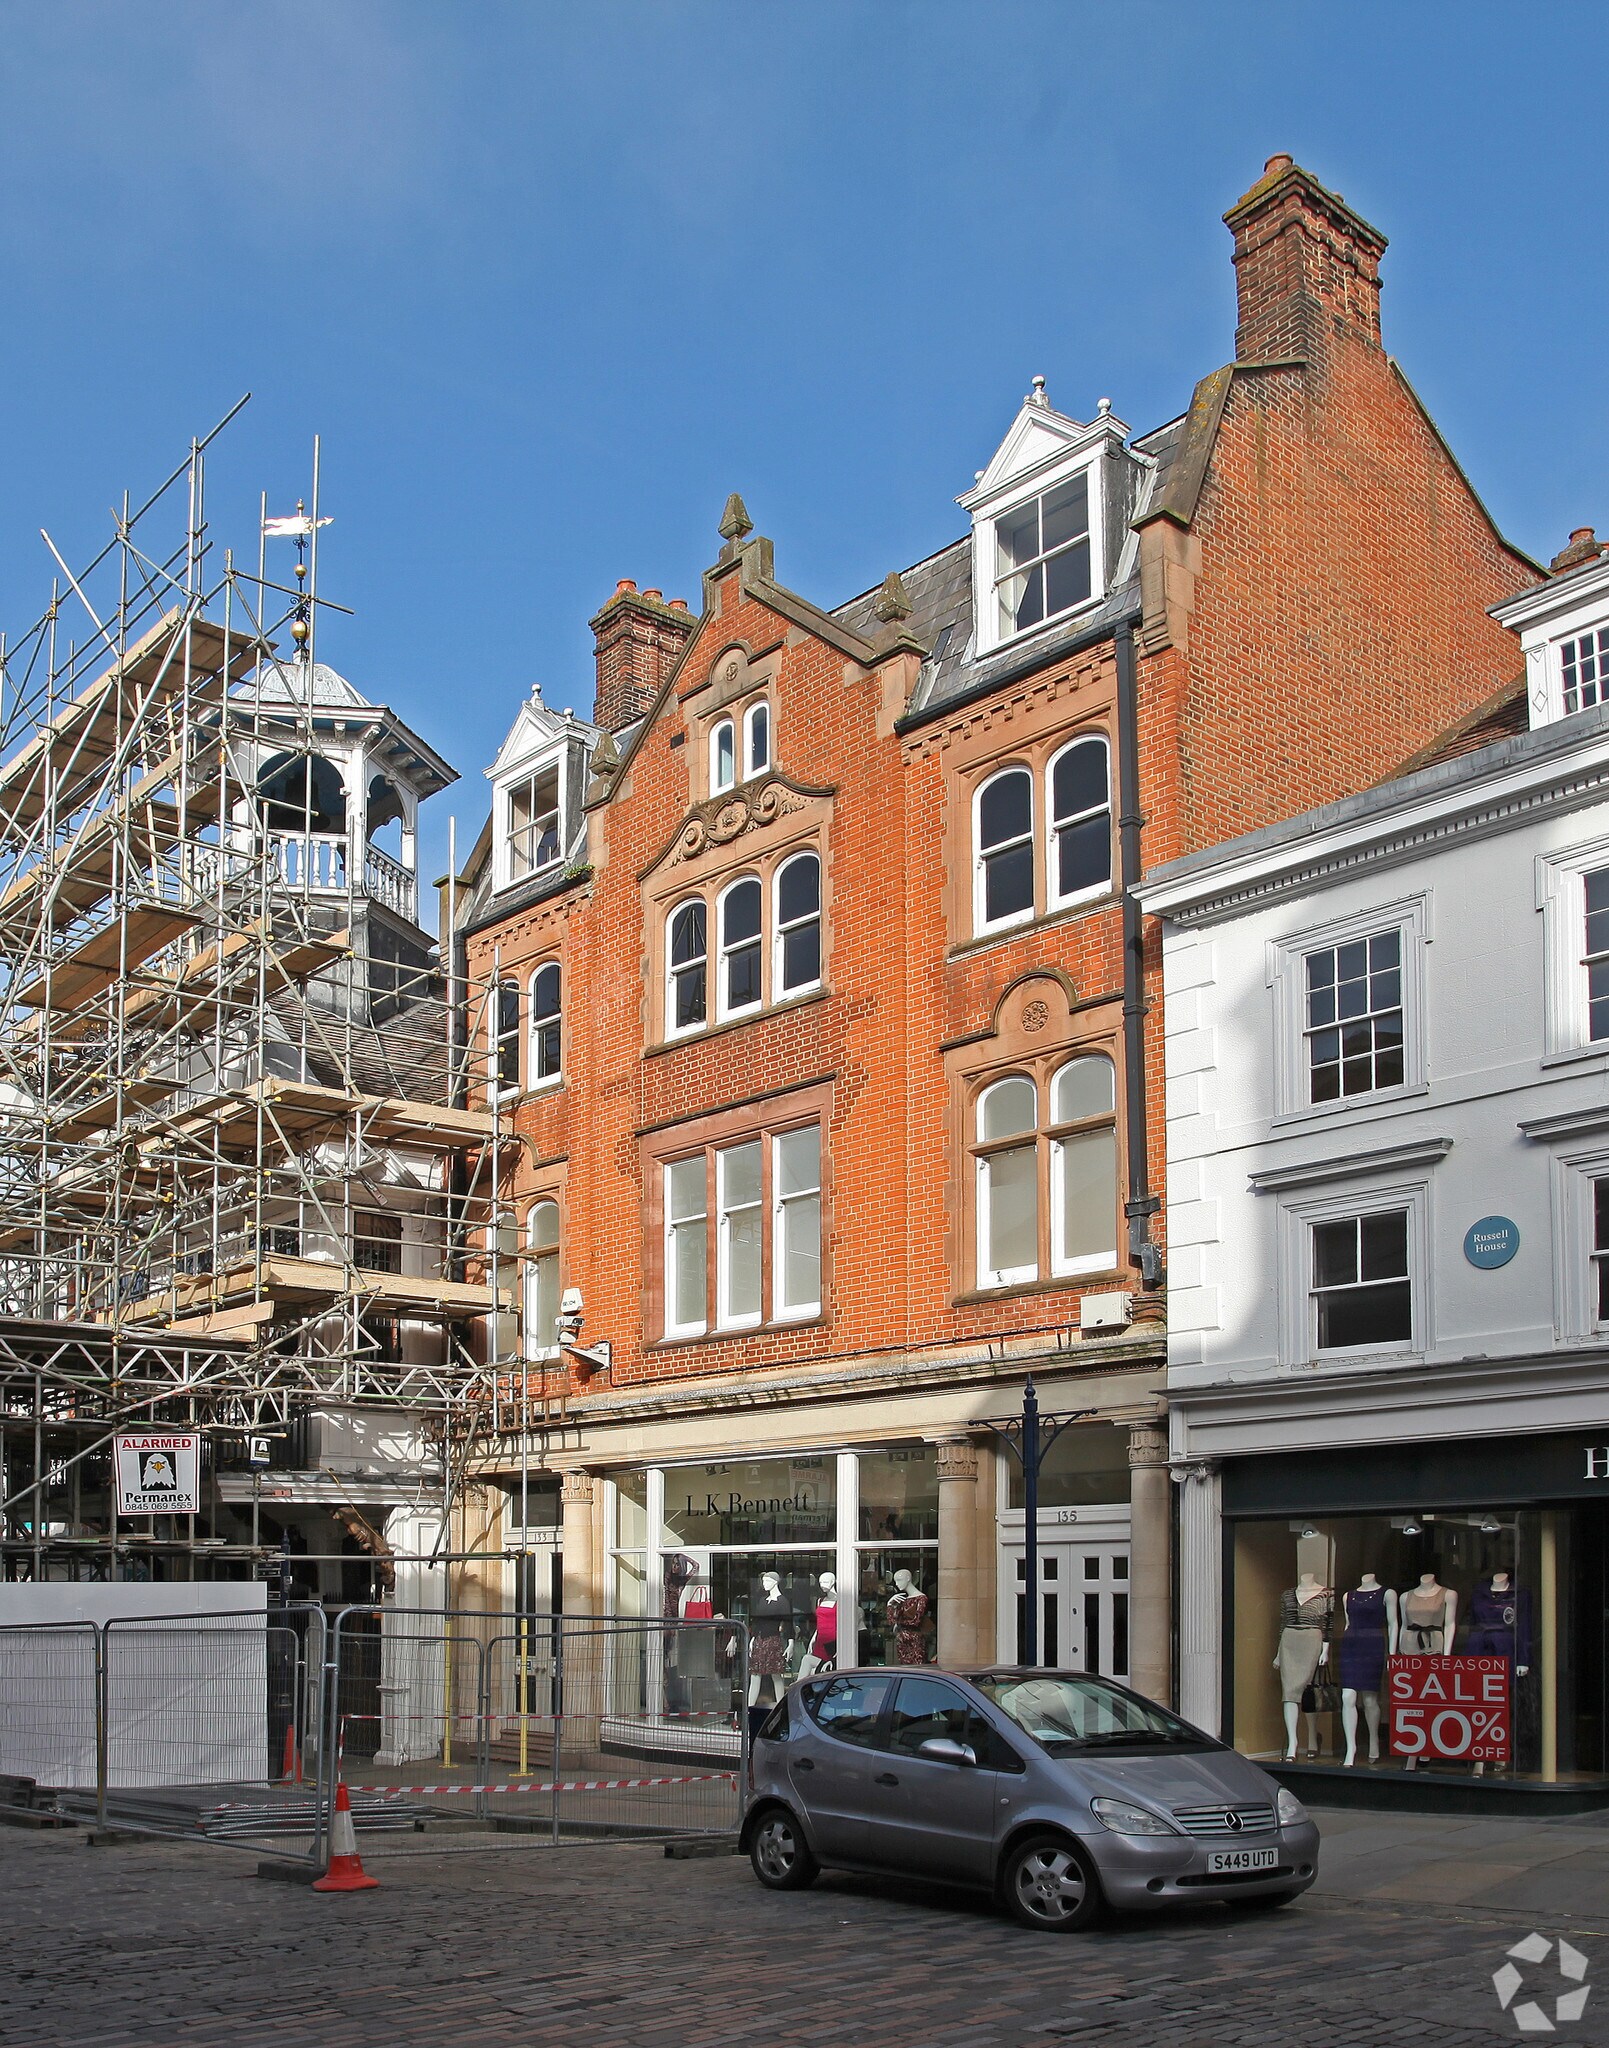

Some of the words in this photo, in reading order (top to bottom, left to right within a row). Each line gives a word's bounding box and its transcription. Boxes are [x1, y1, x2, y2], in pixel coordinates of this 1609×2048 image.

[1473, 1229, 1508, 1242] Russell
[1475, 1242, 1507, 1253] House
[122, 1438, 192, 1449] ALARMED
[125, 1492, 192, 1503] Permanex
[125, 1503, 149, 1511] 0845
[1057, 1510, 1078, 1523] 135
[1391, 1658, 1422, 1670] MID
[1430, 1659, 1505, 1671] SEASON
[1392, 1672, 1505, 1702] SALE
[1393, 1709, 1506, 1756] 50%
[1471, 1746, 1506, 1758] OFF
[1214, 1853, 1250, 1870] S449
[1252, 1850, 1274, 1866] UTD
